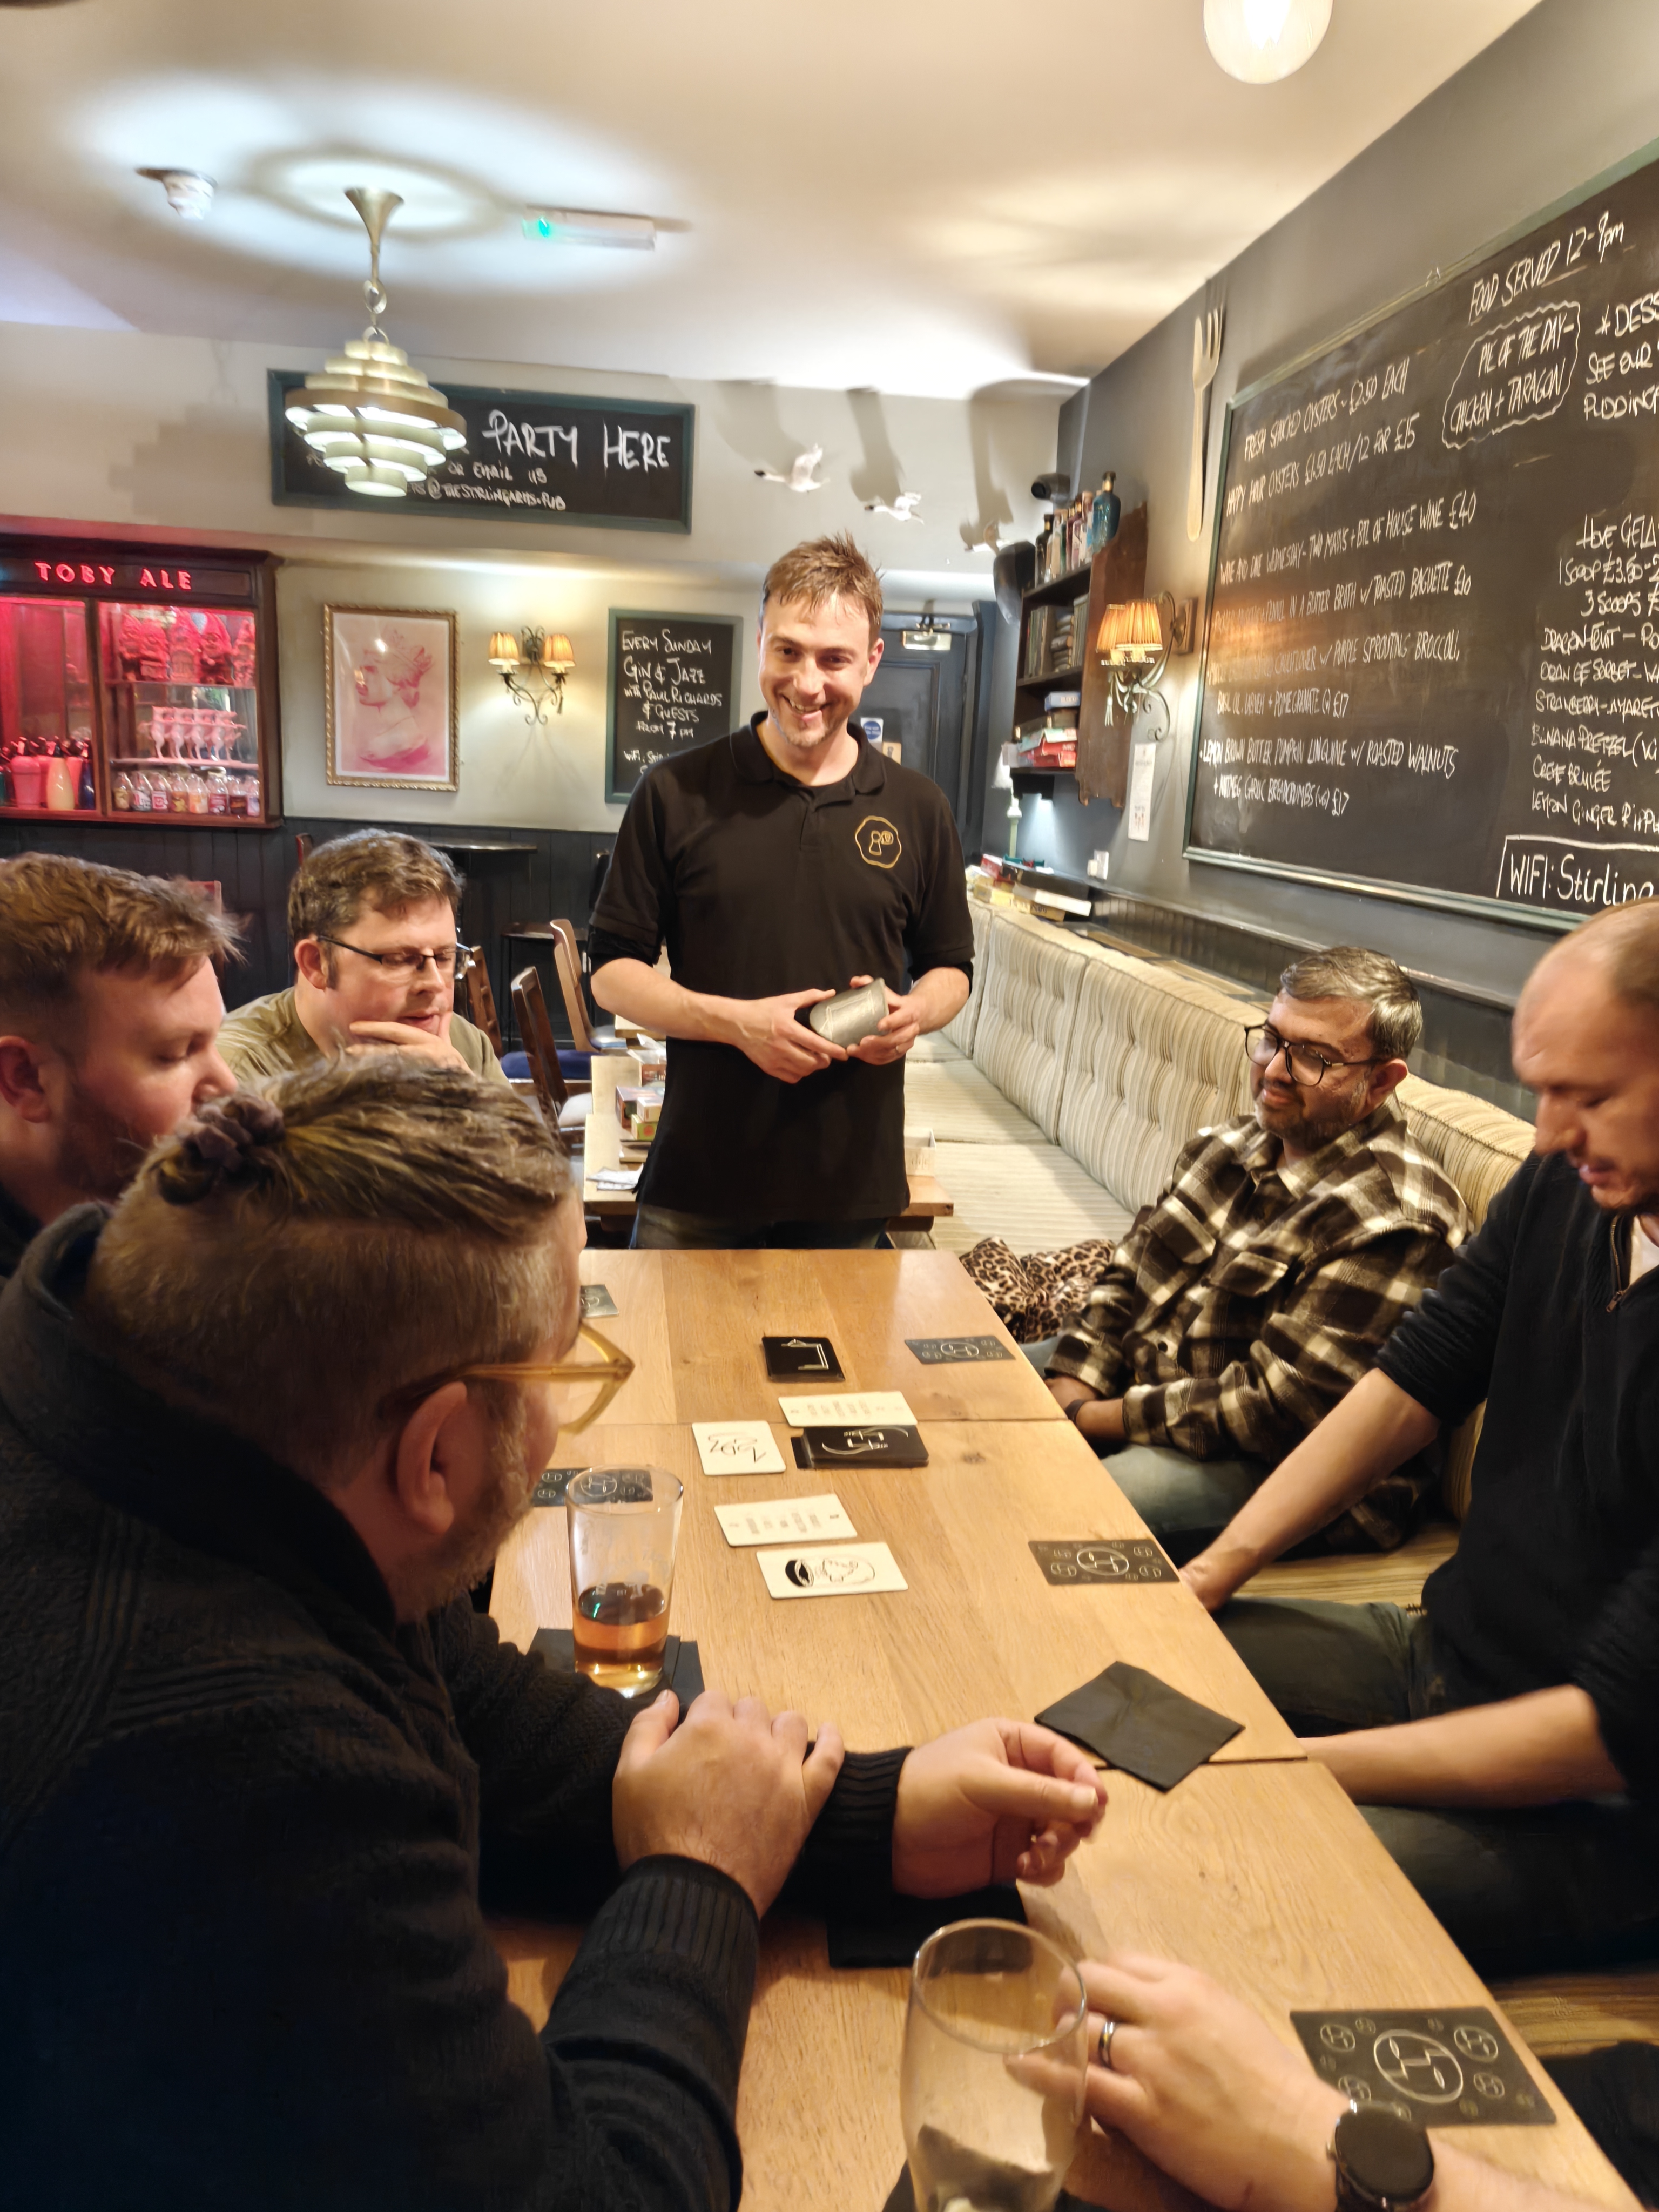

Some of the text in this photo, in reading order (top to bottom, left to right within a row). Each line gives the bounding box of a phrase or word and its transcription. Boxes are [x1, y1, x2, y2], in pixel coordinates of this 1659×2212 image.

[1468, 273, 1499, 324] FOOD
[1501, 239, 1560, 307] SERVED
[1478, 340, 1498, 377] PIE
[1498, 334, 1515, 368] OF
[1518, 323, 1542, 365] THE
[1587, 341, 1653, 384] SEE OUR
[1245, 429, 1266, 461] FRESH
[1304, 389, 1340, 433] OYSTERS
[1382, 356, 1409, 400] EACH
[1451, 388, 1492, 435] CHICKEN
[1508, 357, 1566, 415] TARAGON
[1584, 384, 1659, 421] PUDDING
[482, 409, 671, 472] PARTY HERE
[447, 461, 465, 476] OR
[528, 467, 548, 485] US
[1226, 484, 1246, 517] HAPPY
[1249, 475, 1266, 506] HOUR
[1269, 461, 1299, 498] OYSTERS
[1374, 426, 1391, 454] FOR
[1394, 412, 1420, 452] £15
[1309, 530, 1323, 563] TWO
[1324, 527, 1349, 561] MAINS
[1373, 516, 1385, 543] OF
[1386, 503, 1417, 539] HOUSE
[1420, 497, 1444, 531] WINE
[1449, 490, 1476, 530] £40
[1621, 512, 1659, 549] GELA
[35, 561, 192, 590] TOBY ALE
[1306, 588, 1330, 617] BUTTER
[1334, 581, 1357, 611] BROTH
[1374, 570, 1405, 606] TOASTED
[1410, 560, 1453, 600] BAGUETTE
[1454, 565, 1472, 596] £10
[622, 628, 712, 656] EVERY SUNDAY
[1363, 631, 1411, 663] SPROUTING
[624, 655, 651, 684] GIN
[666, 657, 706, 685] JAZZ
[643, 680, 670, 703] PAUL
[671, 685, 723, 707] RICHARDS
[655, 703, 700, 723] GUESTS
[1274, 687, 1320, 717] POMEGRANATE
[1333, 691, 1349, 718] £17
[1203, 738, 1223, 767] LEMON
[1224, 737, 1245, 764] BROWN
[1247, 737, 1272, 766] BUTTER
[1274, 737, 1305, 766] PUMPKIN
[1307, 736, 1347, 766] LINGUINE
[1366, 738, 1404, 767] ROASTED
[1408, 739, 1459, 779] WALNUTS
[1244, 773, 1266, 802] GARLIC
[1267, 777, 1315, 808] BREADCRUMBS
[1332, 787, 1350, 817] £17
[1532, 787, 1567, 819] LEMON
[1573, 799, 1617, 831] GINGER
